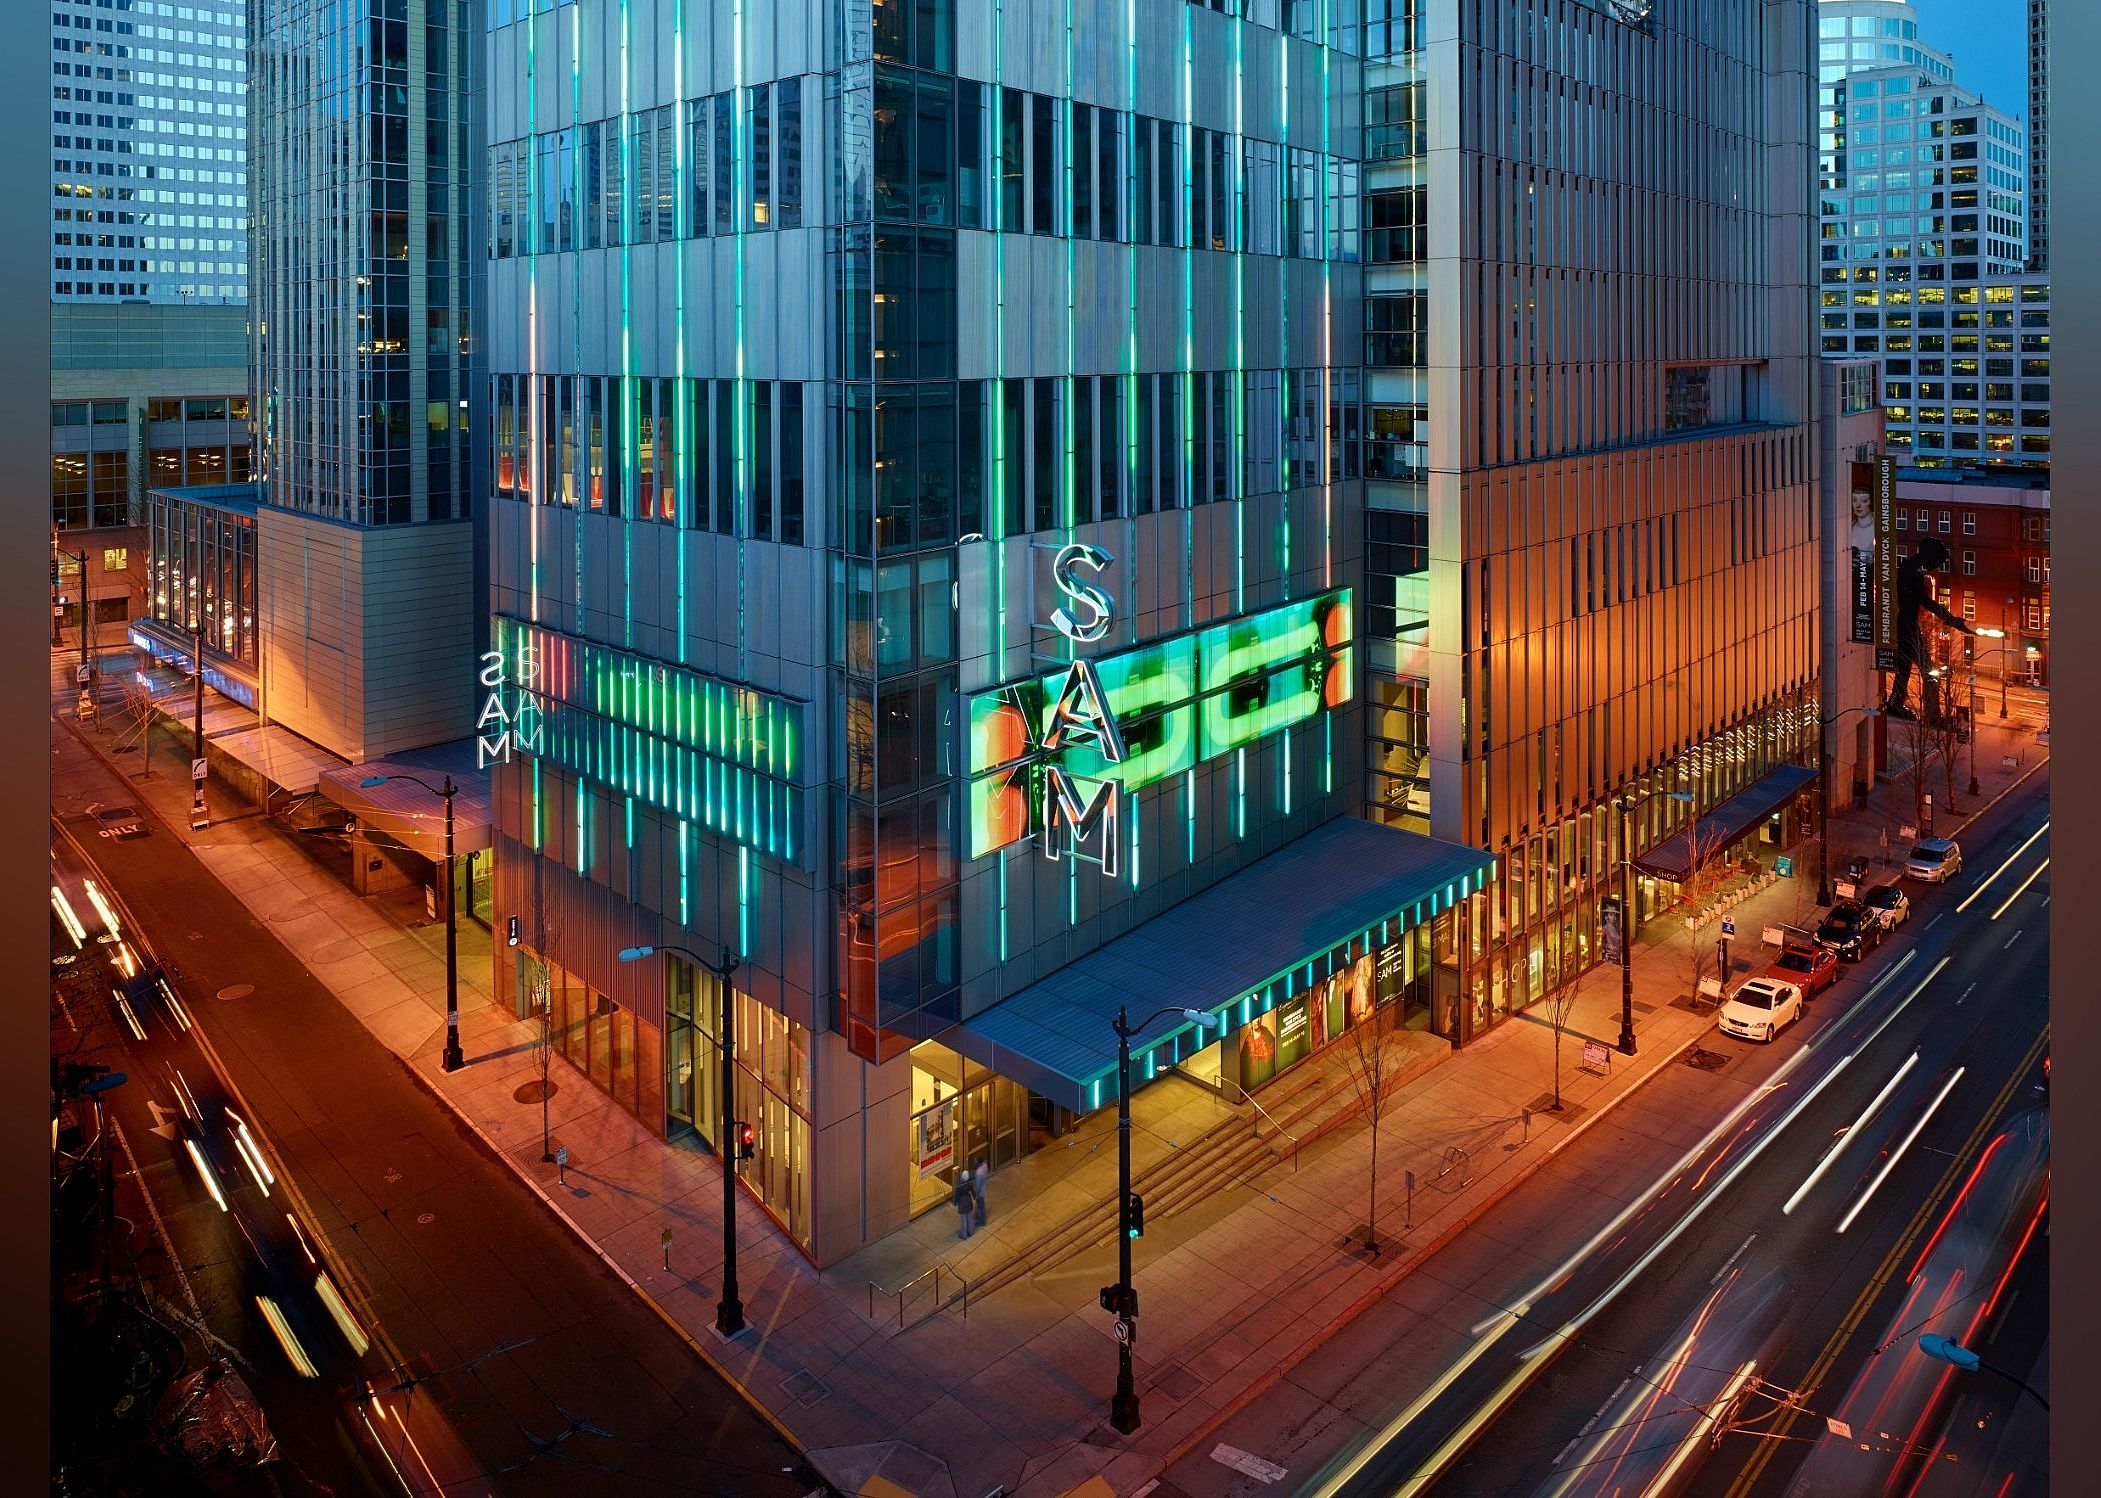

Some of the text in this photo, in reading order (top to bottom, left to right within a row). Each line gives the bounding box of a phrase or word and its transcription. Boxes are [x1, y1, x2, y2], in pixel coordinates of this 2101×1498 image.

[1881, 459, 1890, 644] REMBRANDT VAN DYCK GAINSBOROUGH
[1859, 591, 1867, 607] FEB
[1042, 543, 1128, 877] SAM
[98, 824, 138, 838] ONLY
[1656, 870, 1678, 880] SHOP
[1377, 964, 1392, 983] SAM
